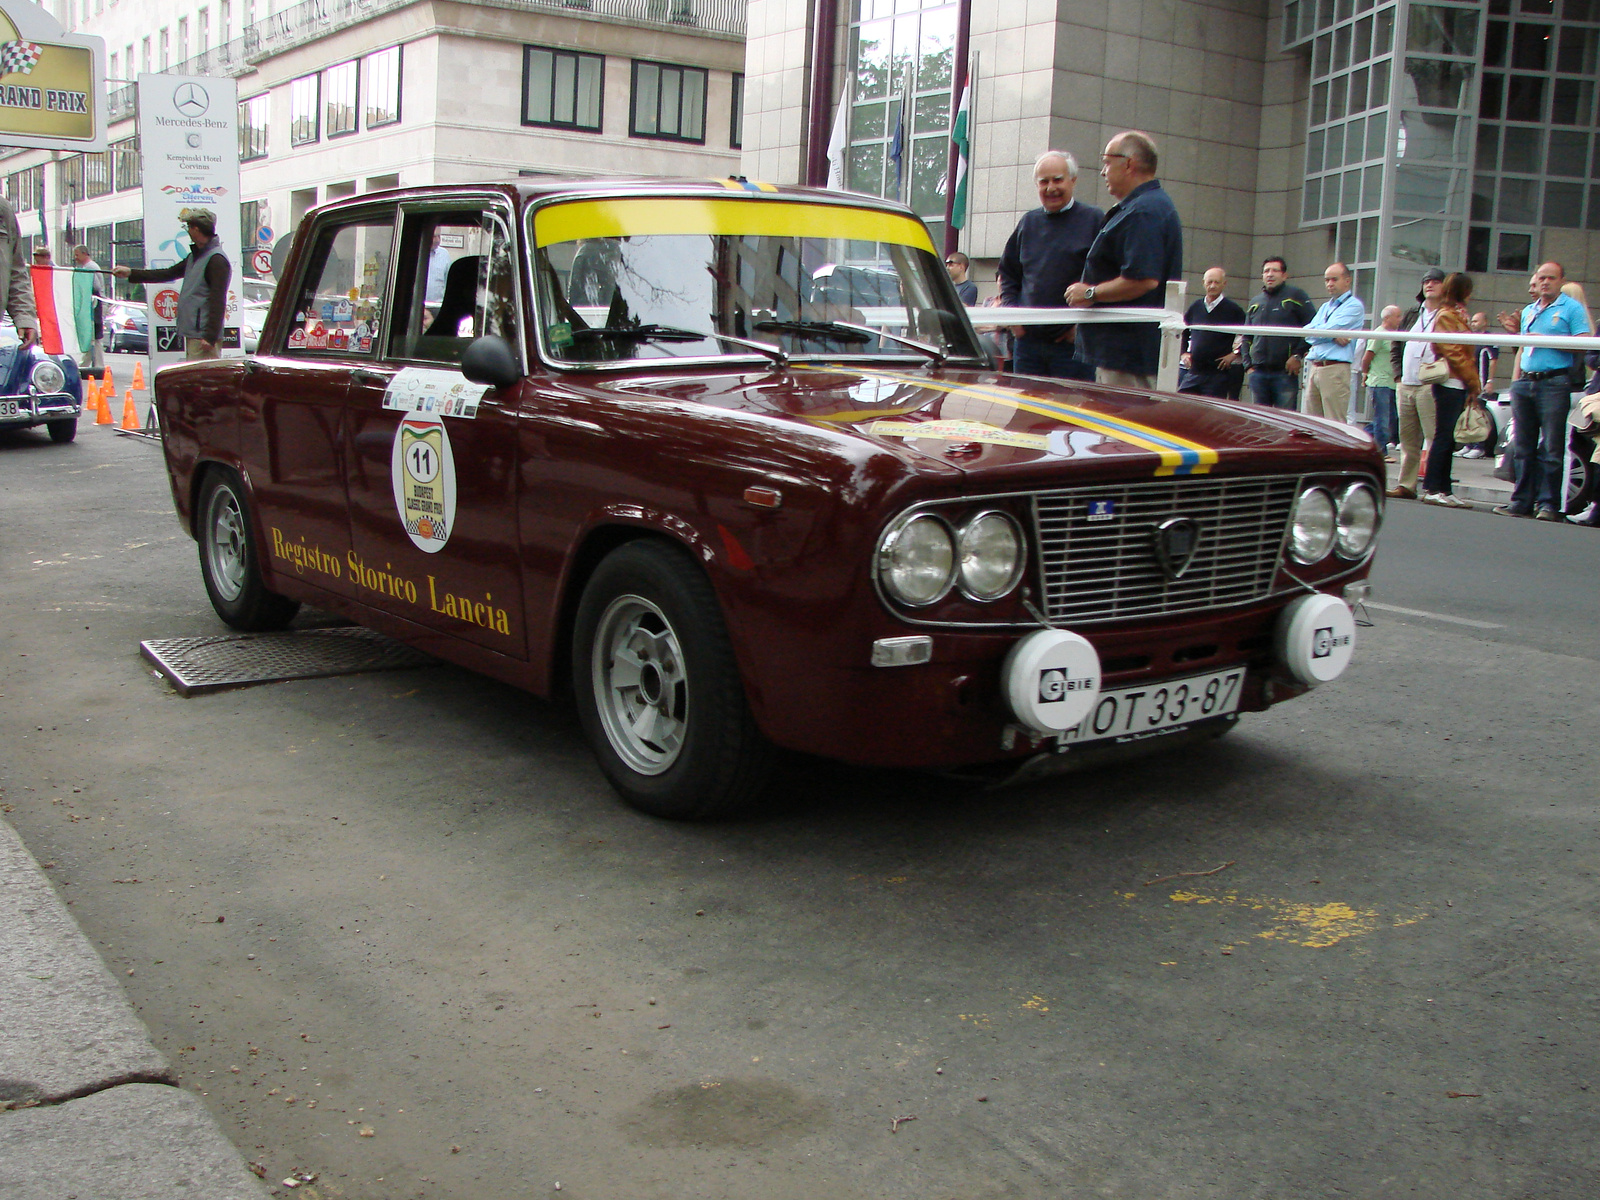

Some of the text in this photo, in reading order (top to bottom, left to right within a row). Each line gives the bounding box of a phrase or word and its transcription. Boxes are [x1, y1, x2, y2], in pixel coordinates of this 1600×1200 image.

[46, 89, 87, 114] PRIX
[155, 116, 228, 129] Mercedes-Benz
[166, 153, 222, 163] Kempinski Hotel
[412, 447, 431, 475] 11
[271, 527, 511, 636] Registro Storico Lancia
